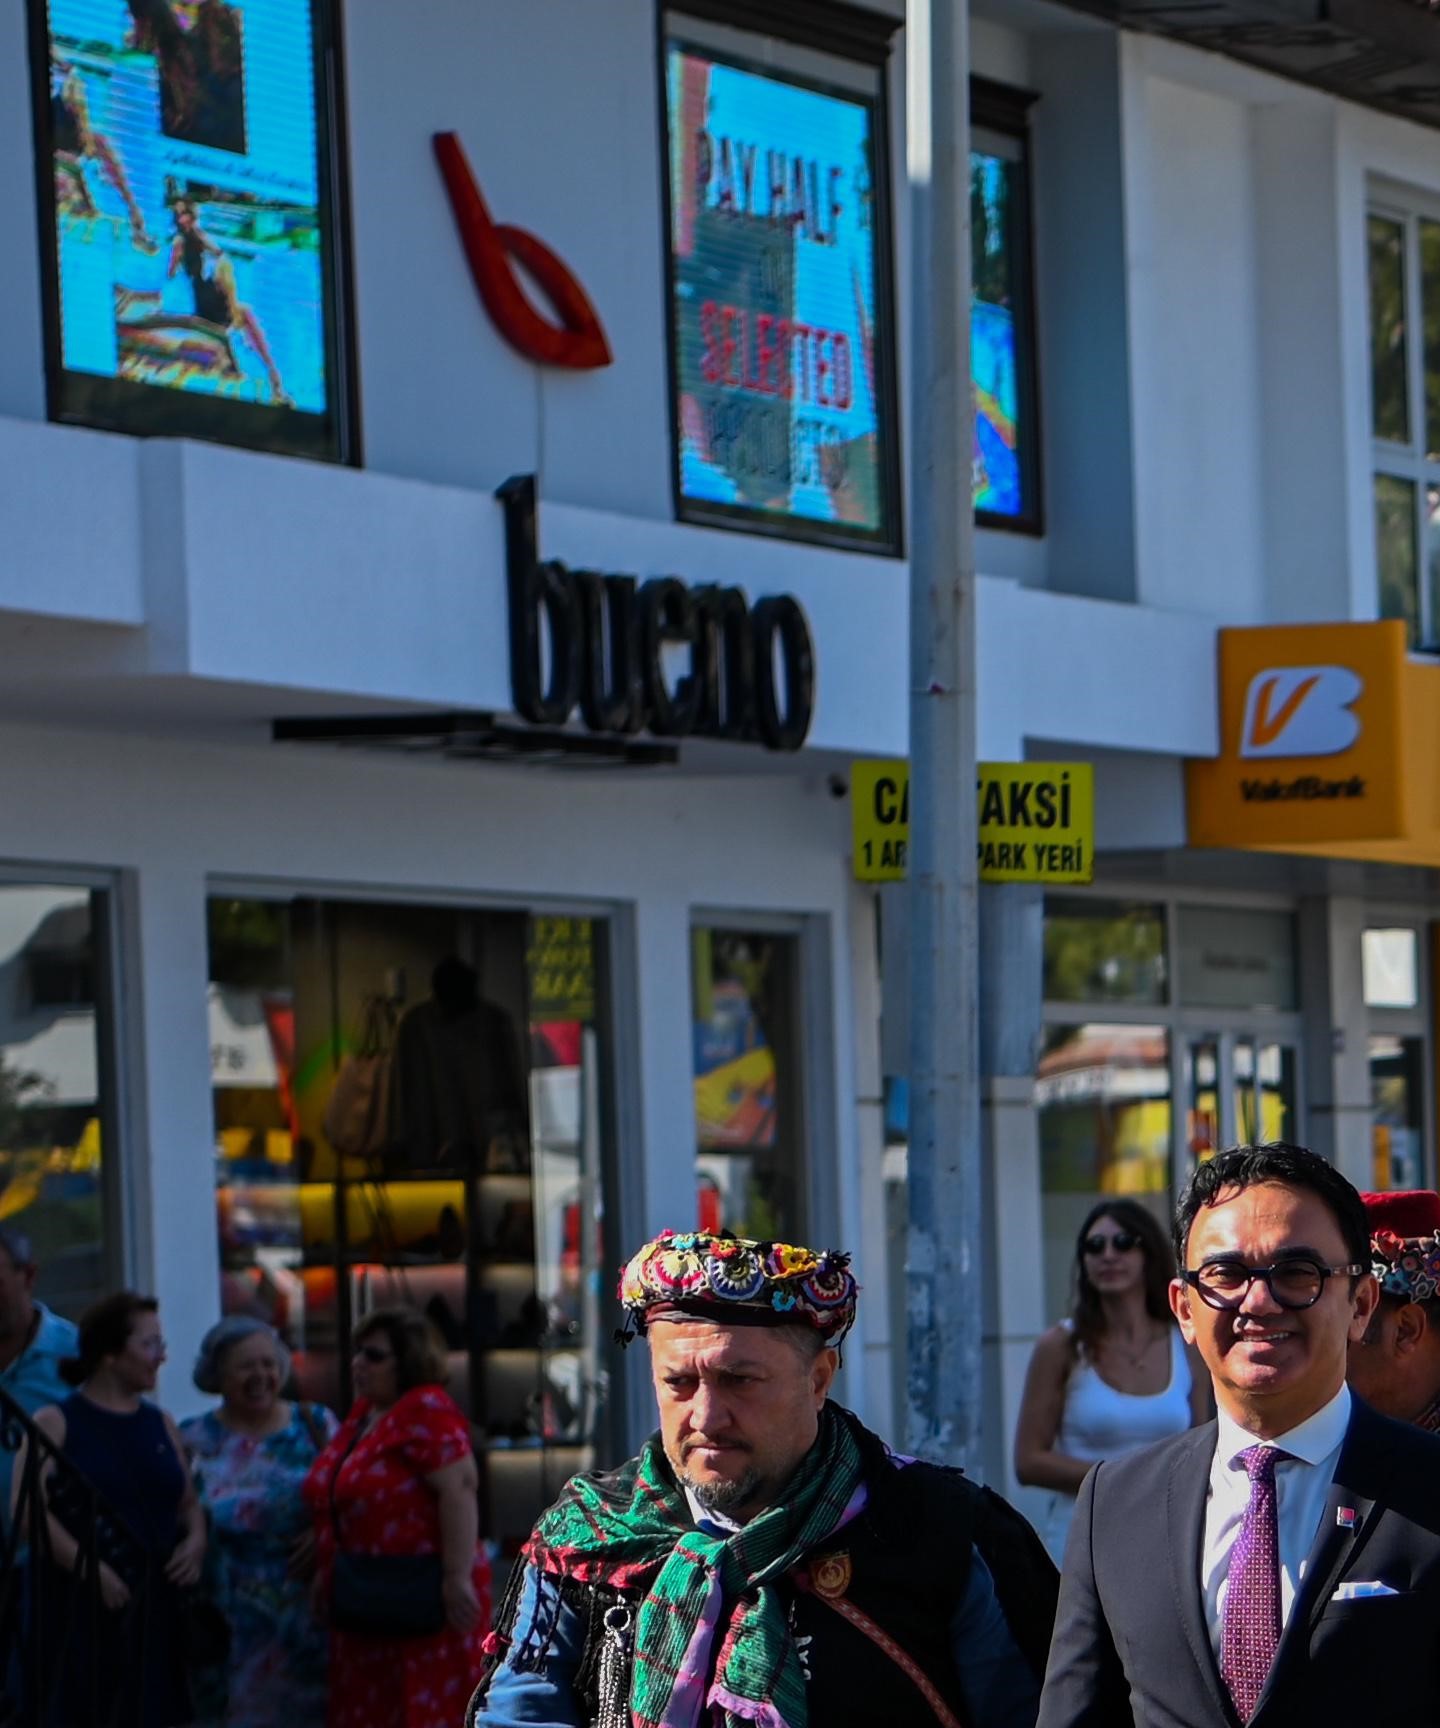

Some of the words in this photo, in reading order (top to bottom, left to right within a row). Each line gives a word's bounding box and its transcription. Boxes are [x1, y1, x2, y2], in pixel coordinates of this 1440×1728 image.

[700, 299, 854, 411] SELECTED
[494, 474, 816, 752] bueno
[976, 771, 1071, 828] AKSİ
[863, 840, 873, 867] 1
[1033, 839, 1082, 872] YERİ
